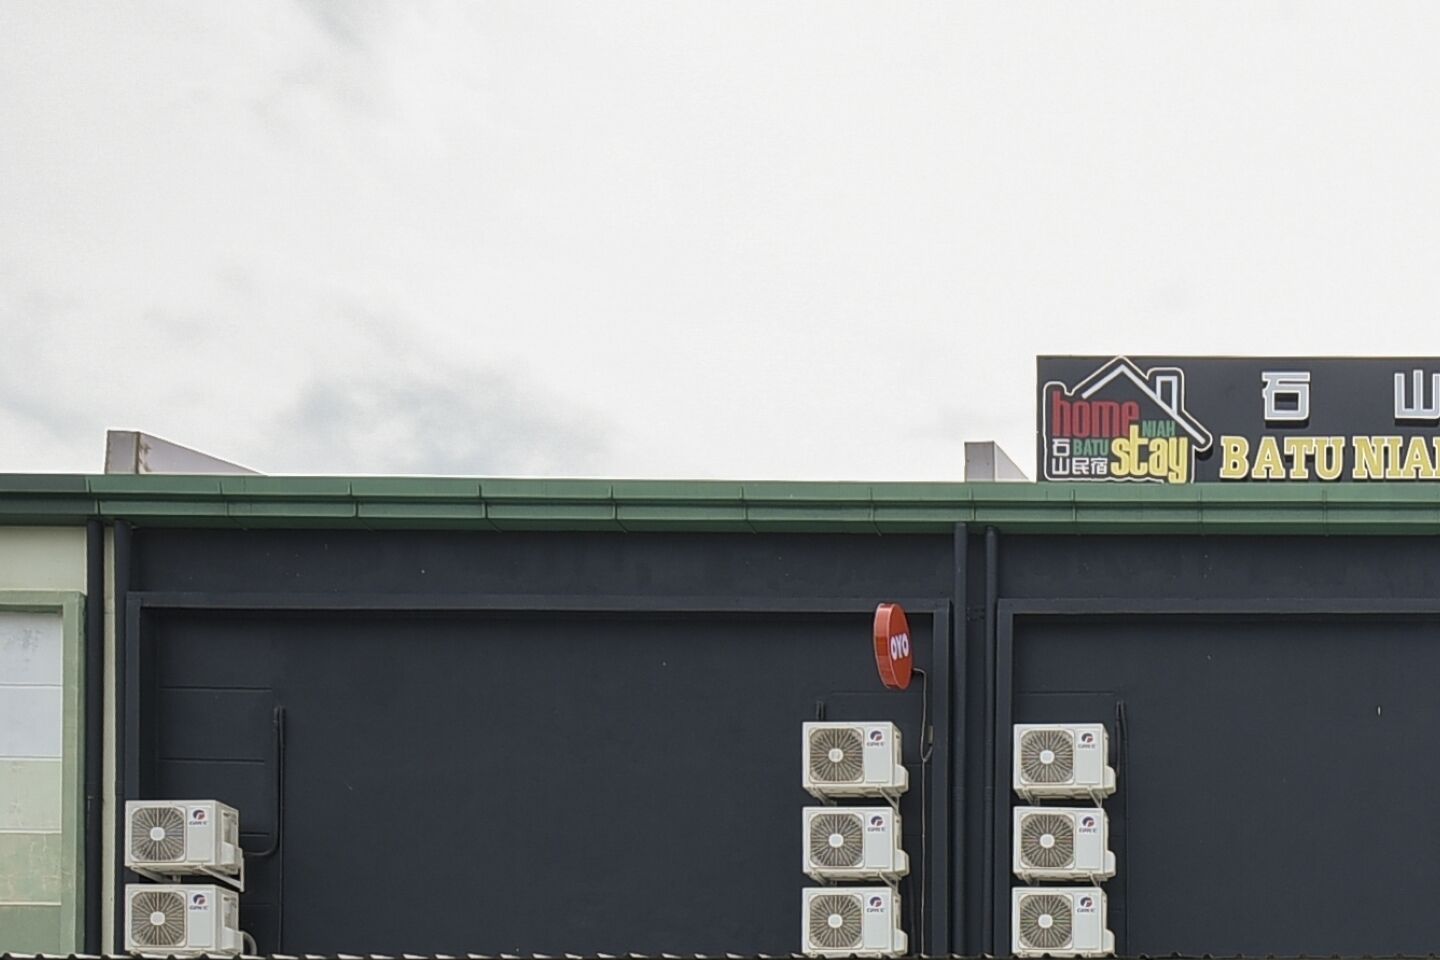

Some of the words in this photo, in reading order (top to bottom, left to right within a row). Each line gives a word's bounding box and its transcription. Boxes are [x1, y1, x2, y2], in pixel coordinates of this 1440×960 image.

[1052, 390, 1140, 438] home
[1142, 420, 1176, 437] NIAH
[1052, 438, 1070, 456] 石
[1073, 439, 1109, 455] BATU
[1110, 425, 1188, 483] stay
[1219, 436, 1345, 480] BATU
[891, 633, 909, 661] OYO
